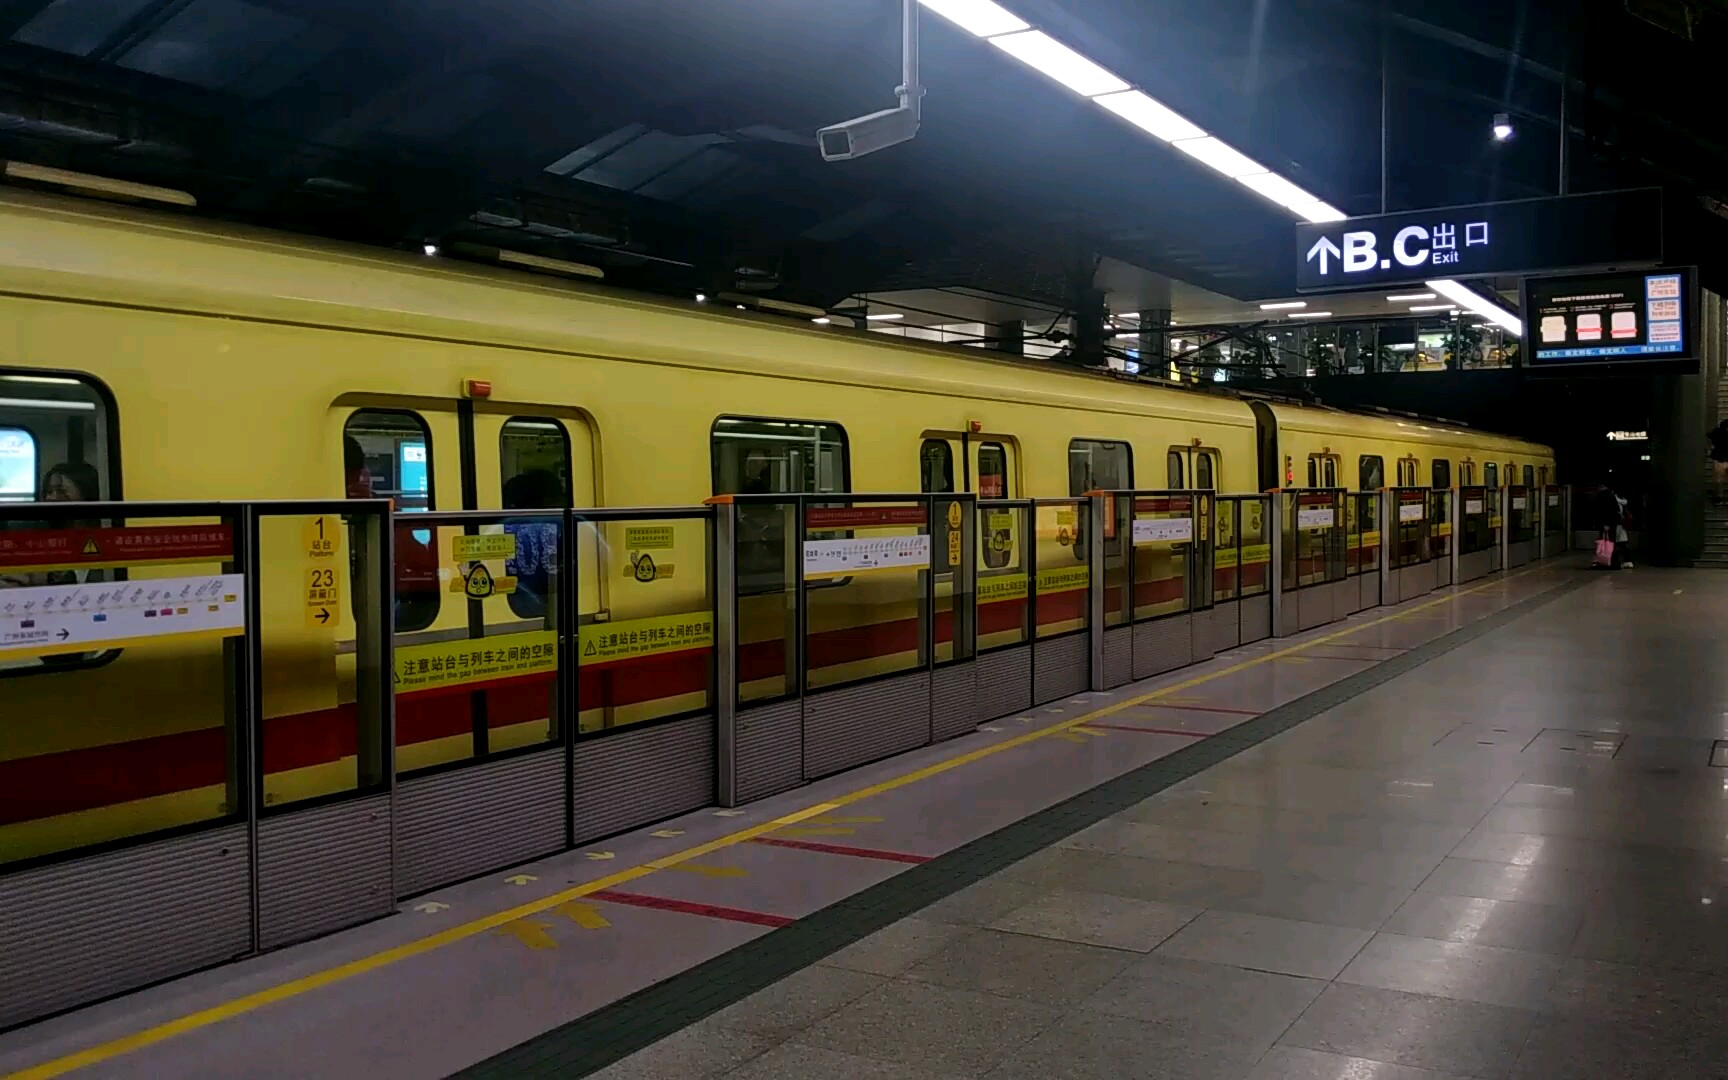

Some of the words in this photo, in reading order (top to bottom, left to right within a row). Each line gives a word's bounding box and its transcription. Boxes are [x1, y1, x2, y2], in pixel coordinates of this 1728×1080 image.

[1432, 222, 1489, 250] 出口
[1343, 225, 1430, 273] B.C
[1432, 251, 1460, 265] Exit
[315, 517, 323, 540] 1
[308, 550, 335, 558] Platform
[312, 540, 331, 549] 站台
[311, 569, 334, 588] 23
[308, 588, 337, 599] 屏蔽门
[598, 622, 711, 649] 注意站台与列车之间的空隙
[403, 643, 554, 677] 注意站台与列车之间的空隙
[403, 676, 426, 685] Please
[429, 672, 444, 681] mind
[447, 670, 457, 678] the
[460, 669, 472, 678] gap
[474, 665, 499, 675] between
[501, 663, 514, 671] train
[517, 661, 528, 669] and
